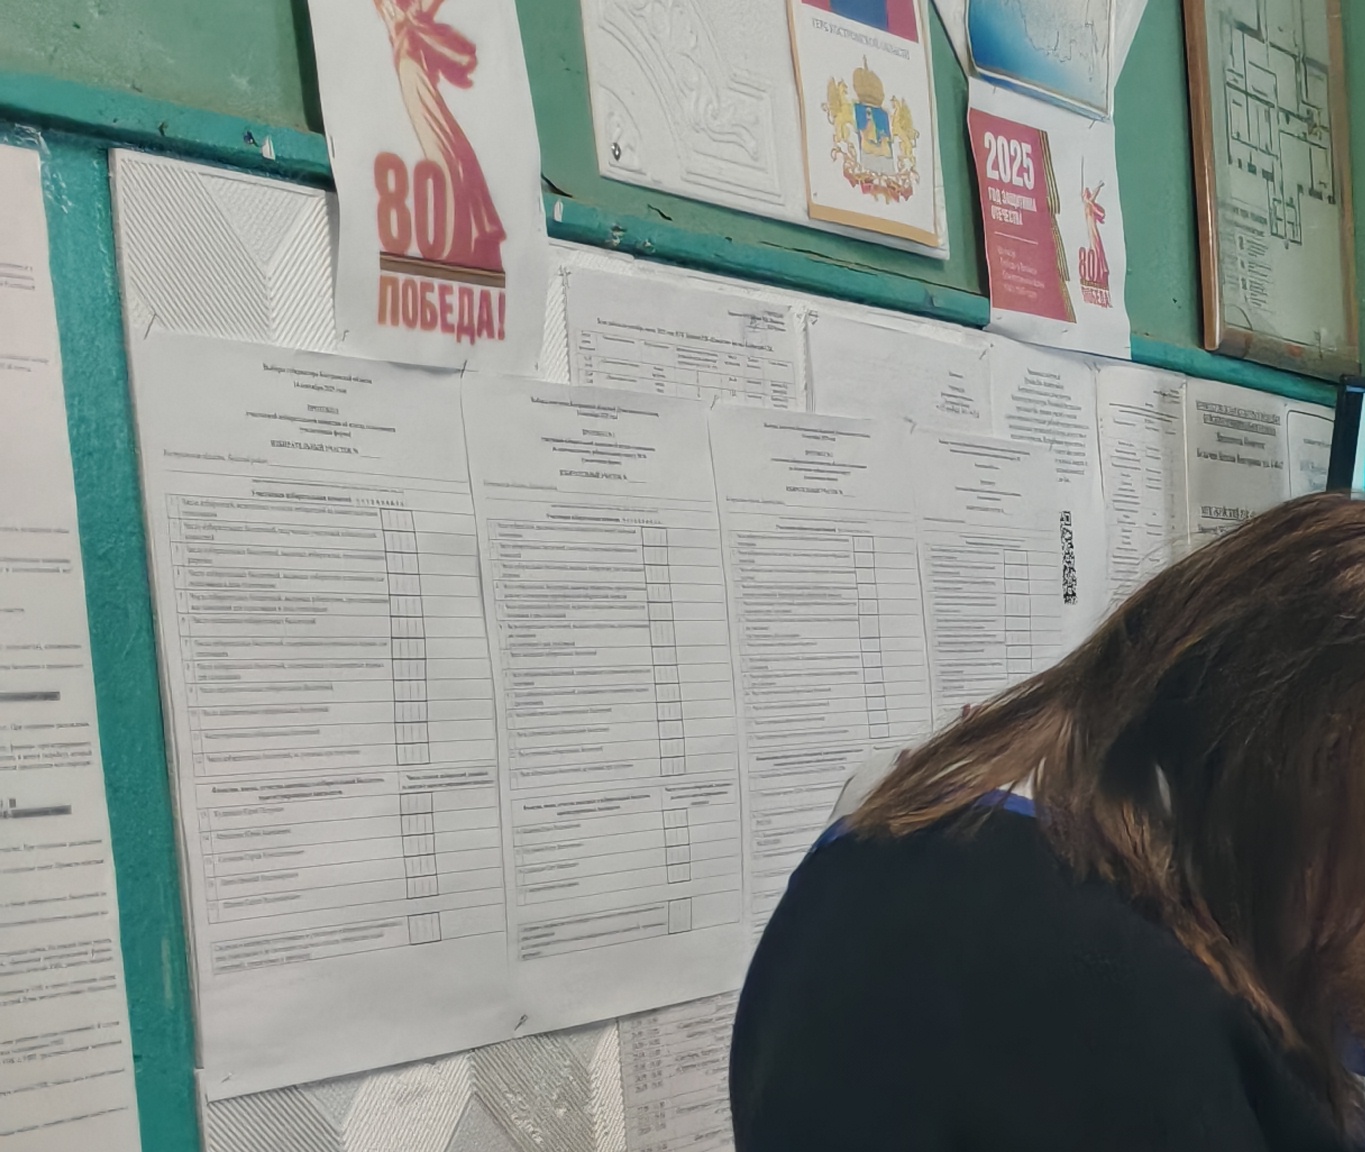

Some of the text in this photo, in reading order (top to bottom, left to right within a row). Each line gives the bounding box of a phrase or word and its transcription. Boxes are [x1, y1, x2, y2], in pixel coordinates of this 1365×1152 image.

[984, 131, 1035, 190] 2025
[374, 151, 447, 260] 80
[1079, 247, 1095, 281] 80
[378, 275, 506, 346] ПОБЕДА!
